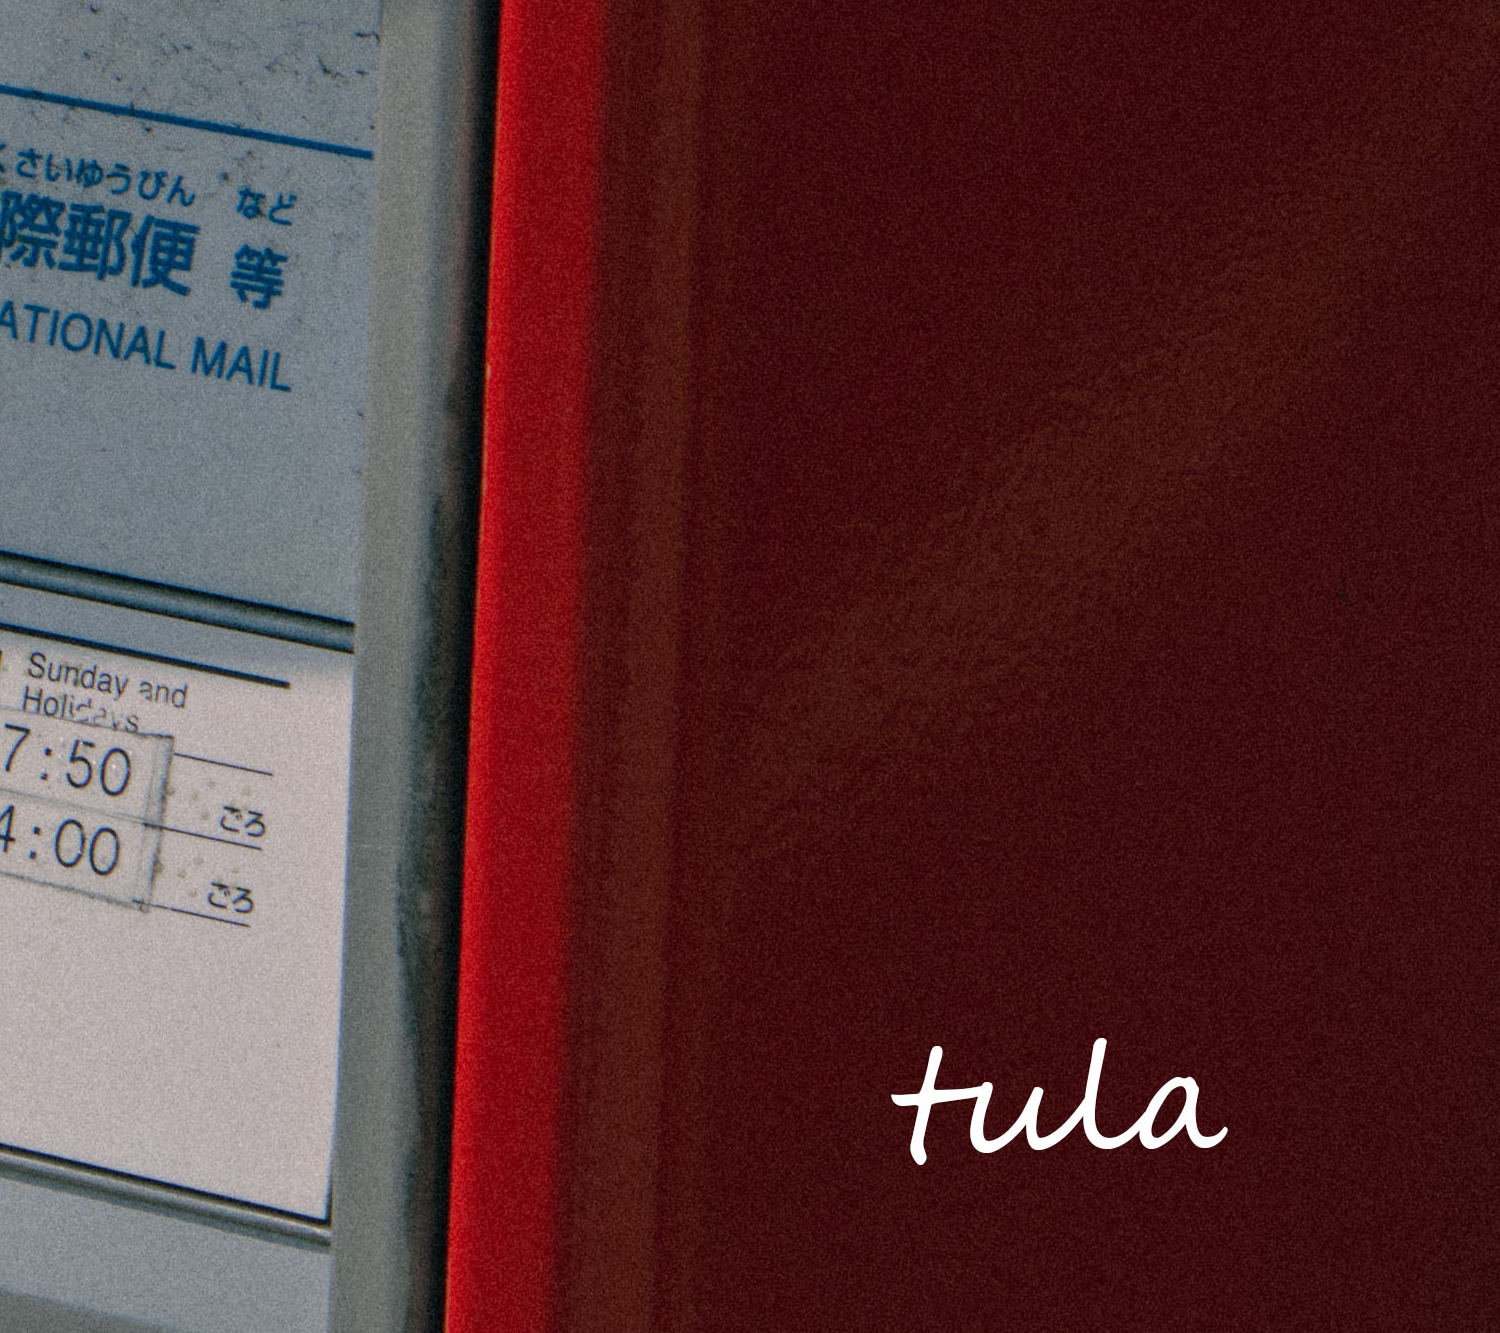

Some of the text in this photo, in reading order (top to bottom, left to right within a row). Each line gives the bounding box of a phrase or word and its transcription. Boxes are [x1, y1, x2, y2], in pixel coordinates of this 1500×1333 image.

[235, 185, 298, 228] など
[190, 335, 293, 394] MAIL
[27, 650, 130, 702] Sunday
[138, 680, 189, 710] and
[3, 722, 267, 839] 7:50 ごろ
[207, 880, 254, 915] ごろ
